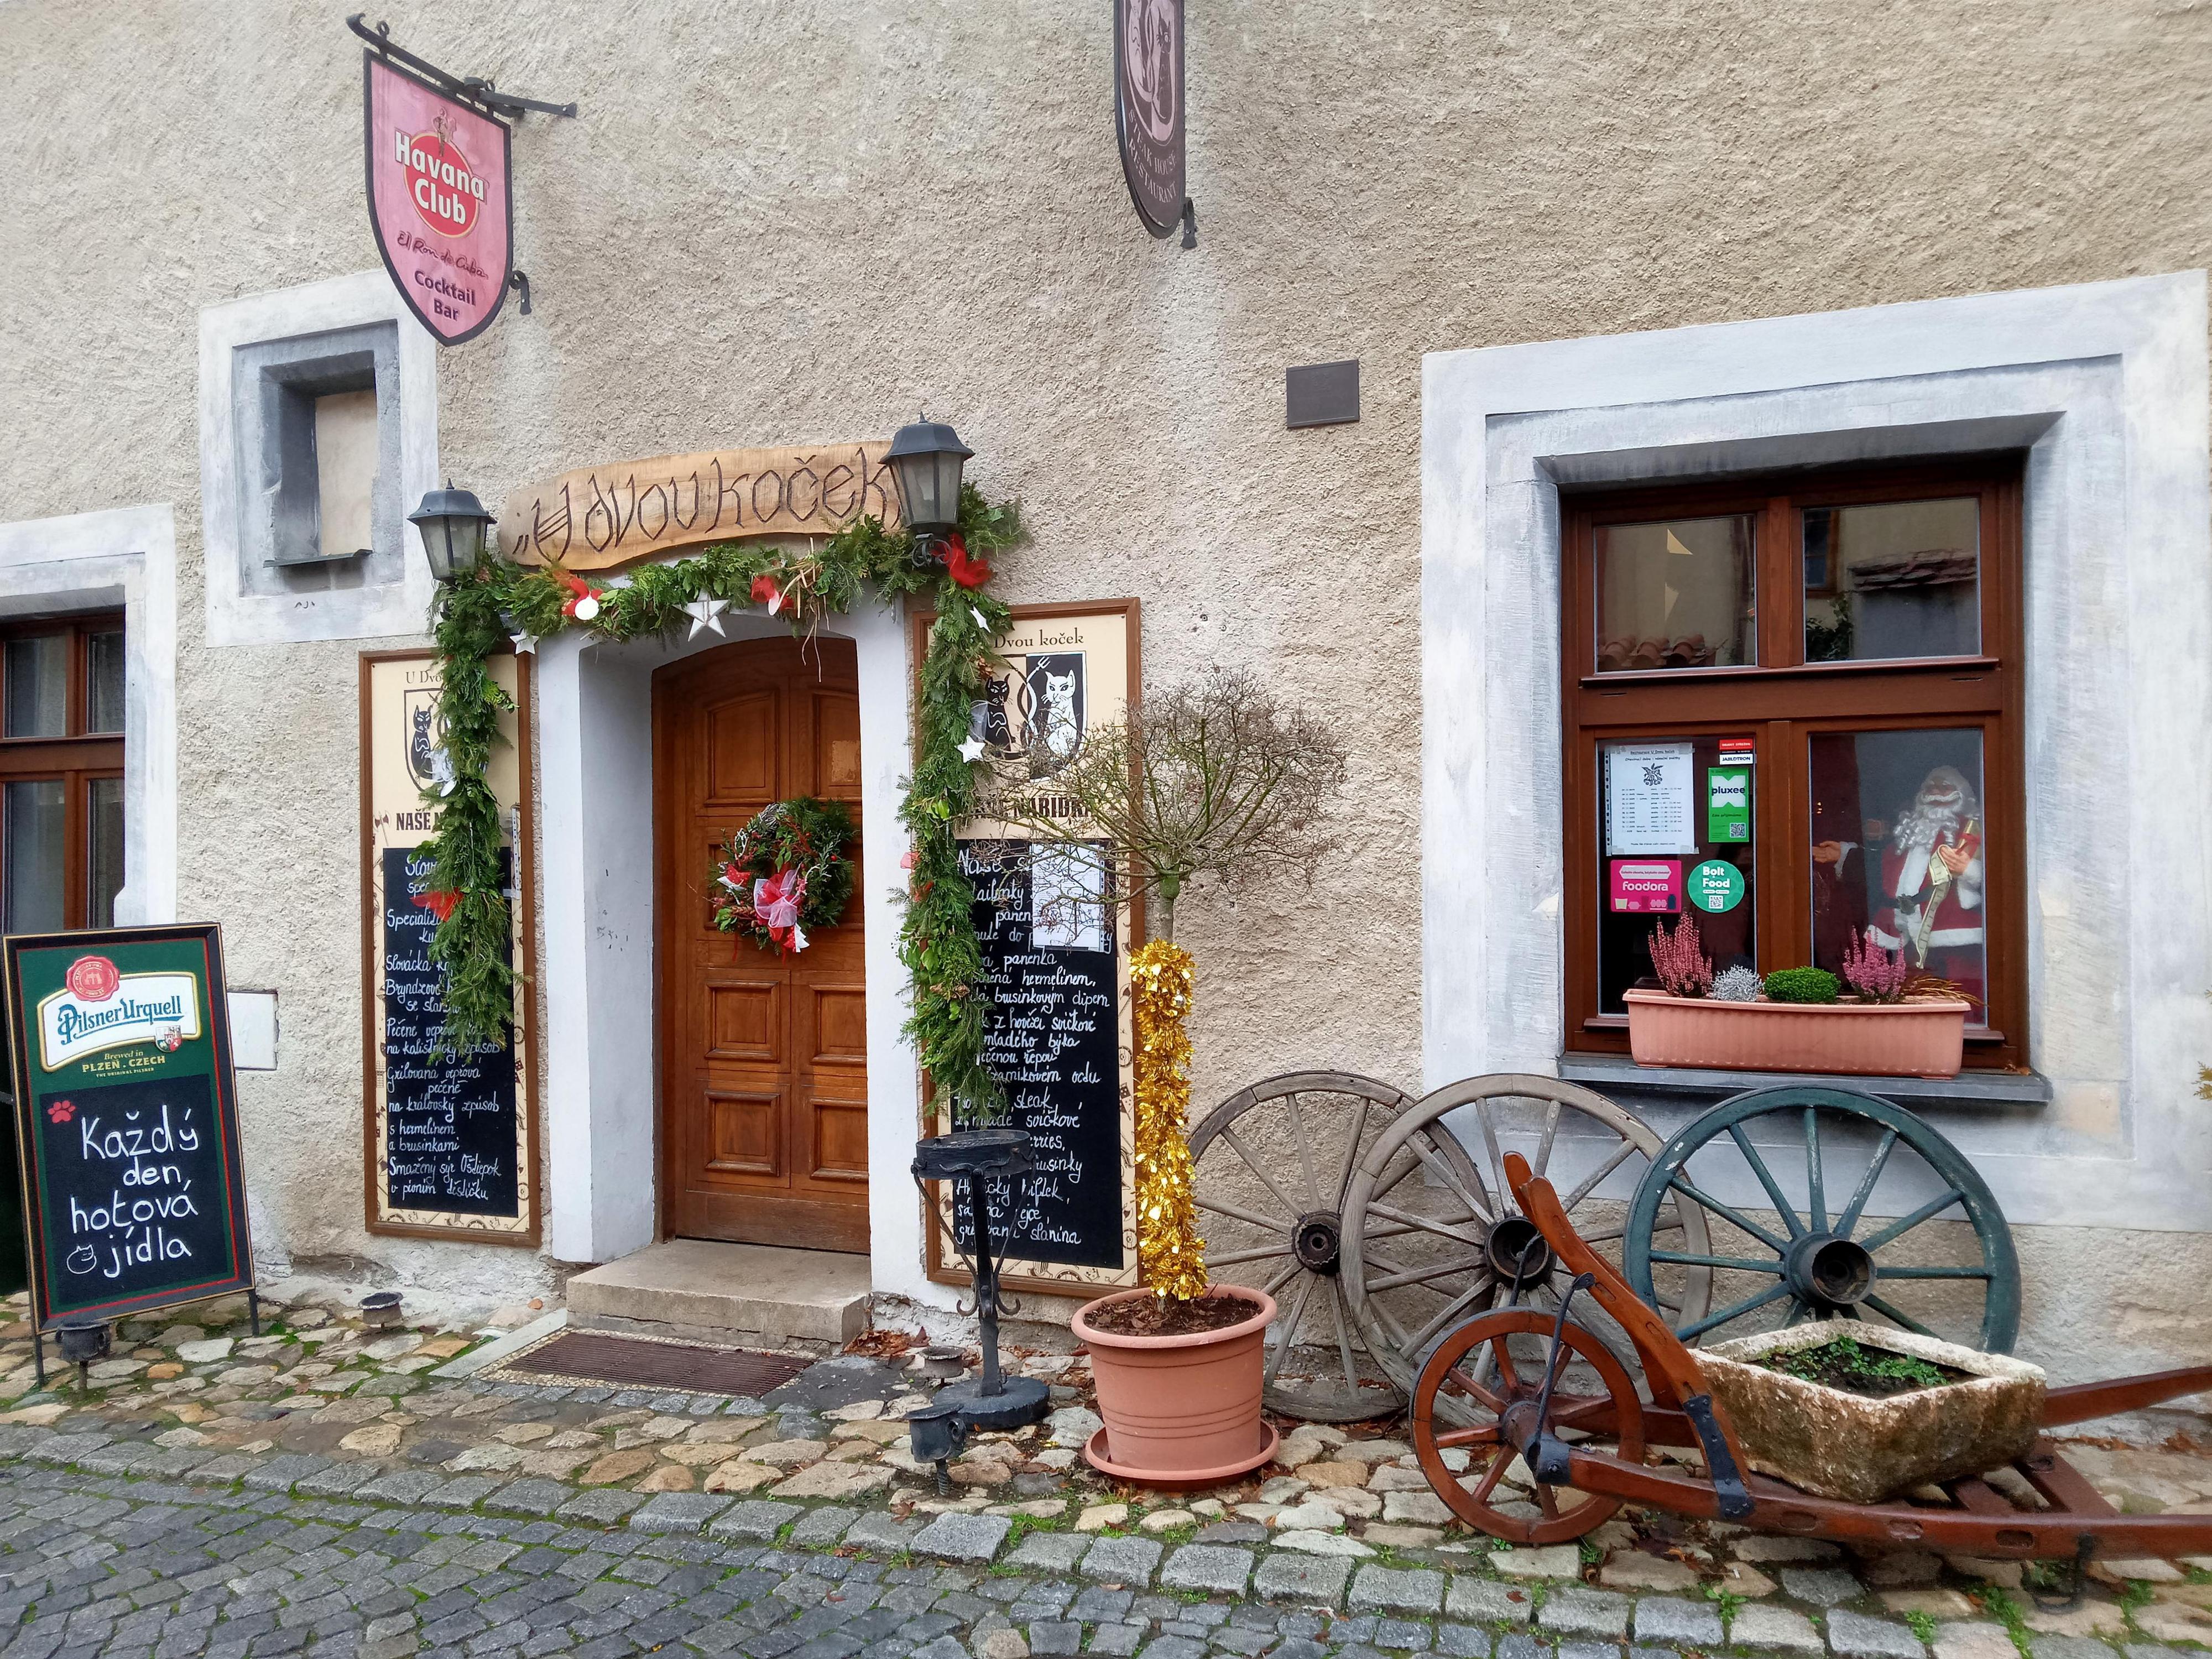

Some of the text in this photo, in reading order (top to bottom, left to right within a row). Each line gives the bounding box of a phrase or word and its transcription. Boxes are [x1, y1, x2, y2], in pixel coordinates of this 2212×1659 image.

[1129, 109, 1176, 175] STEAK HOUSE
[395, 132, 486, 201] Havana
[1129, 138, 1176, 204] RESTAURANT
[415, 178, 466, 225] Club
[398, 230, 488, 279] El Ron de Cuba
[414, 270, 476, 306] Cocktail
[433, 299, 460, 321] Bar
[995, 627, 1084, 649] Dvou koček
[406, 670, 444, 684] U Dvo
[1712, 786, 1746, 797] pluxee
[396, 808, 431, 830] NAŠE
[1702, 865, 1725, 877] Bolt
[1622, 881, 1669, 891] foodora
[1702, 878, 1730, 889] Food
[387, 902, 441, 932] Specialit
[995, 911, 1032, 930] panen
[1009, 927, 1024, 942] do
[1004, 945, 1057, 973] panenka
[405, 1000, 419, 1012] se
[1072, 990, 1110, 1014] dipem
[57, 995, 182, 1046] Pilsner Urquell
[387, 1015, 419, 1037] Pečené
[387, 1045, 400, 1055] na
[983, 1029, 1081, 1055] mladého býka
[82, 1055, 166, 1073] PLZEŇ CZECH
[104, 1051, 133, 1061] Brewed
[445, 1057, 481, 1084] vepřová
[389, 1102, 404, 1113] na
[81, 1105, 200, 1160] Každý
[389, 1124, 395, 1135] s
[389, 1136, 460, 1152] a brusinkami
[123, 1155, 181, 1186] den
[389, 1155, 437, 1185] Smažený
[439, 1155, 456, 1184] sýr
[1035, 1150, 1083, 1184] rusinky
[390, 1183, 399, 1194] v
[70, 1179, 199, 1234] hotová
[1030, 1222, 1082, 1245] slanina
[103, 1224, 192, 1279] jídla
